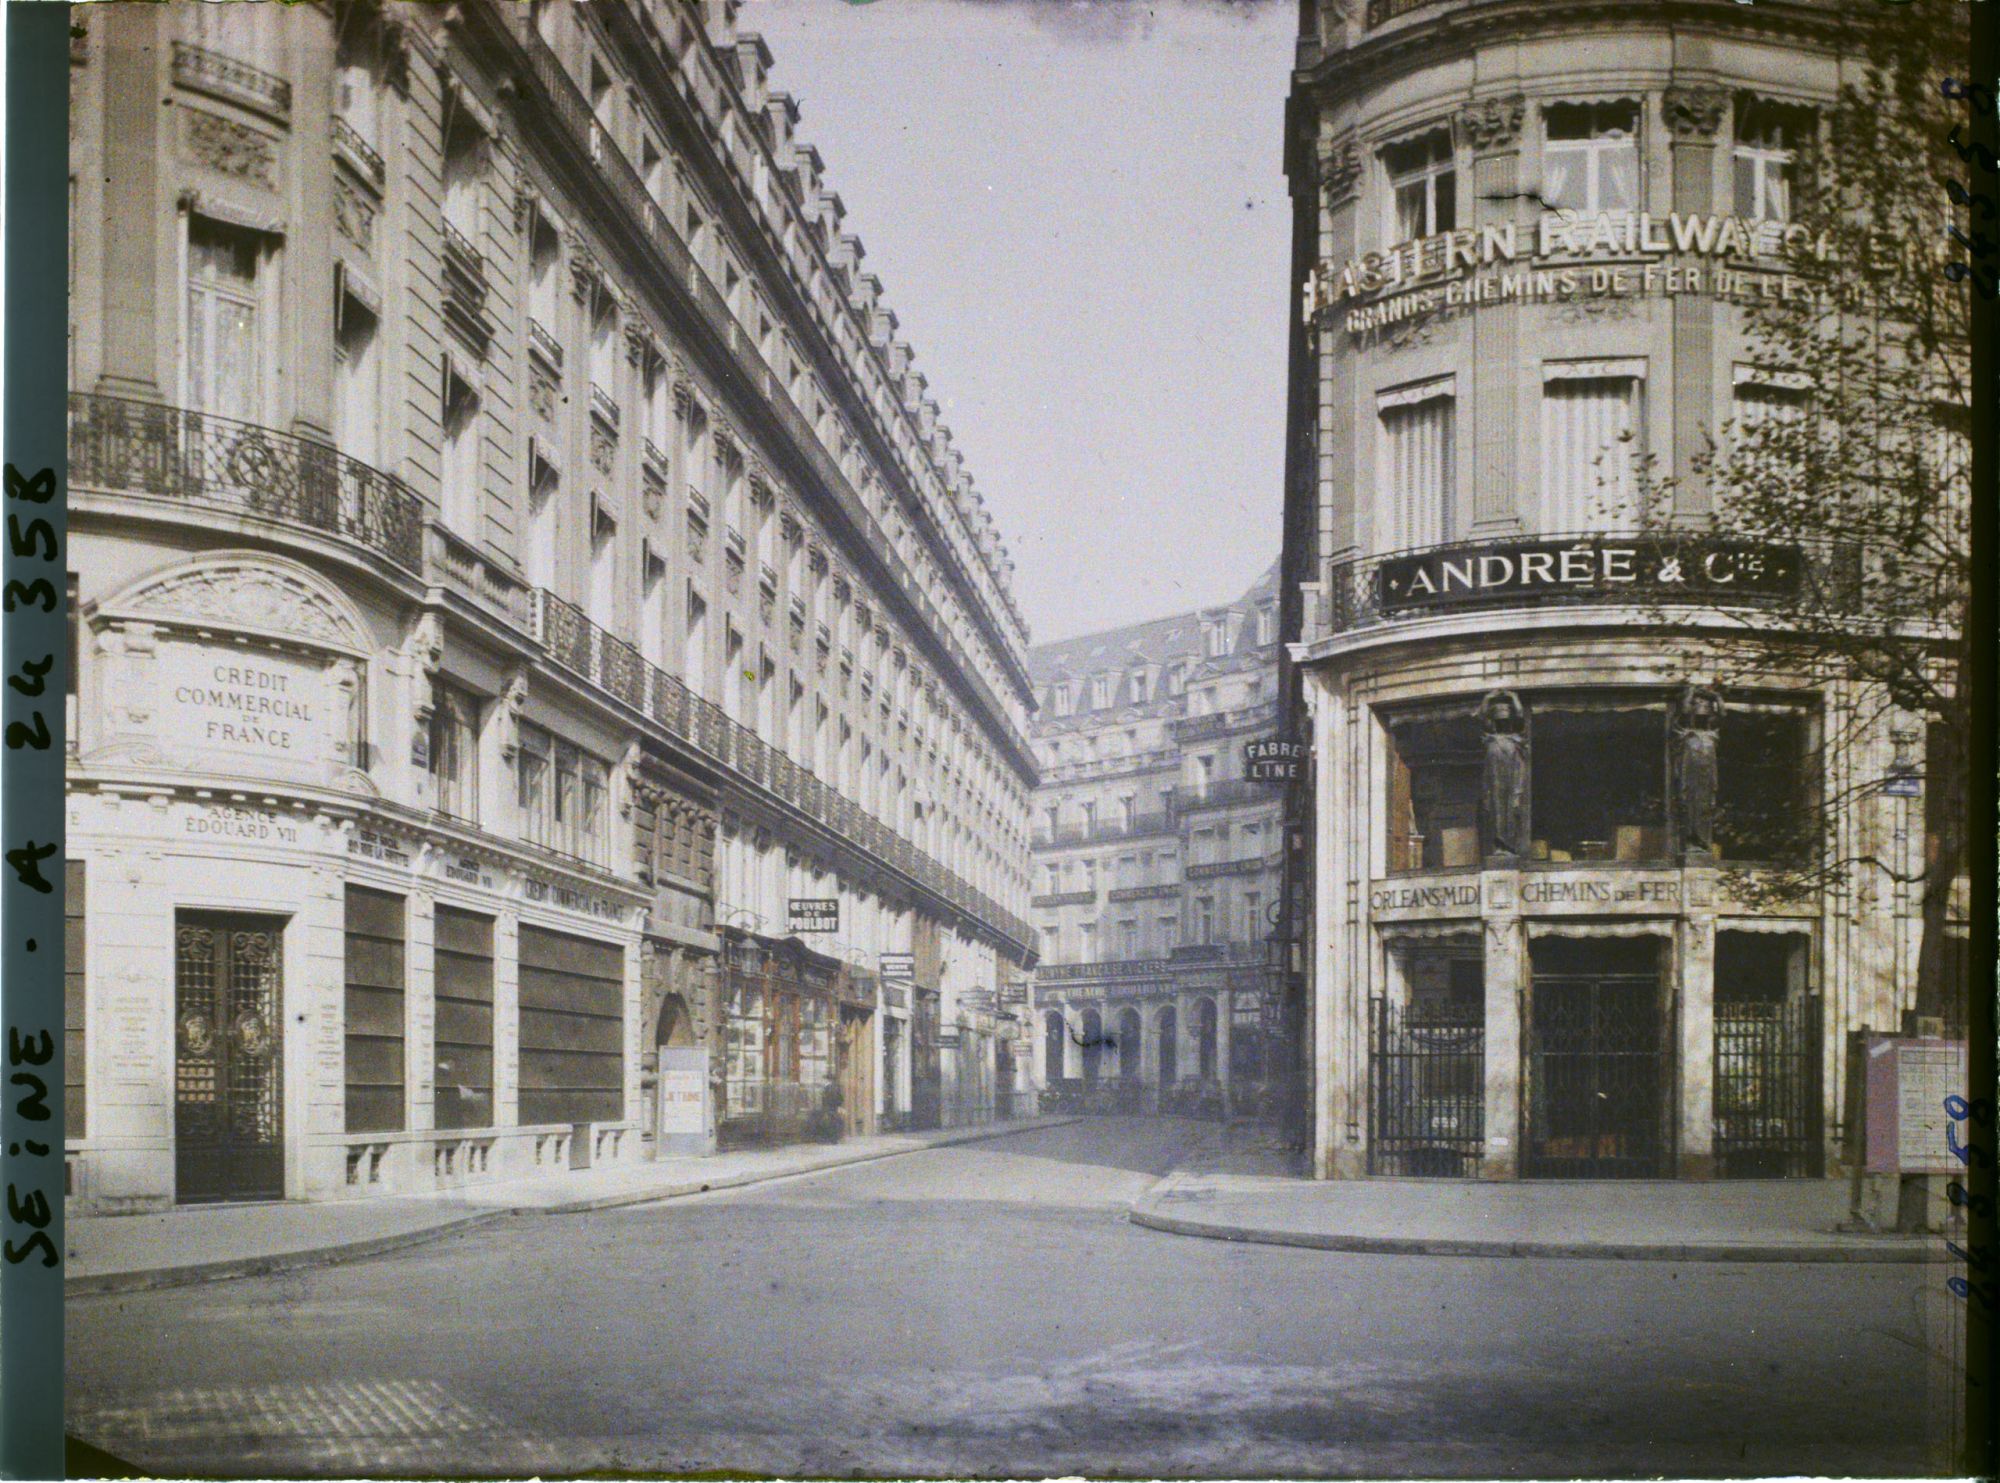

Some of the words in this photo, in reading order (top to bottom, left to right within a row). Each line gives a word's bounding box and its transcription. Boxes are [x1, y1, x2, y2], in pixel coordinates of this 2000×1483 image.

[1446, 269, 1578, 305] CHEMINS
[1592, 268, 1627, 293] DE
[1643, 263, 1700, 292] FER
[1717, 271, 1748, 295] DE
[1407, 543, 1637, 597] ANDRÉE
[1657, 556, 1685, 583] &
[175, 686, 313, 722] COMMERCIAL
[206, 721, 291, 749] FRANCE
[1247, 741, 1304, 759] FABRE
[1252, 763, 1298, 779] LINE
[208, 807, 278, 825] AGENCE
[276, 826, 297, 843] VII
[7, 841, 57, 894] A
[1521, 880, 1611, 903] CHEMINS
[1615, 888, 1636, 902] DE
[1639, 880, 1680, 903] FER
[789, 917, 837, 930] POULBOT
